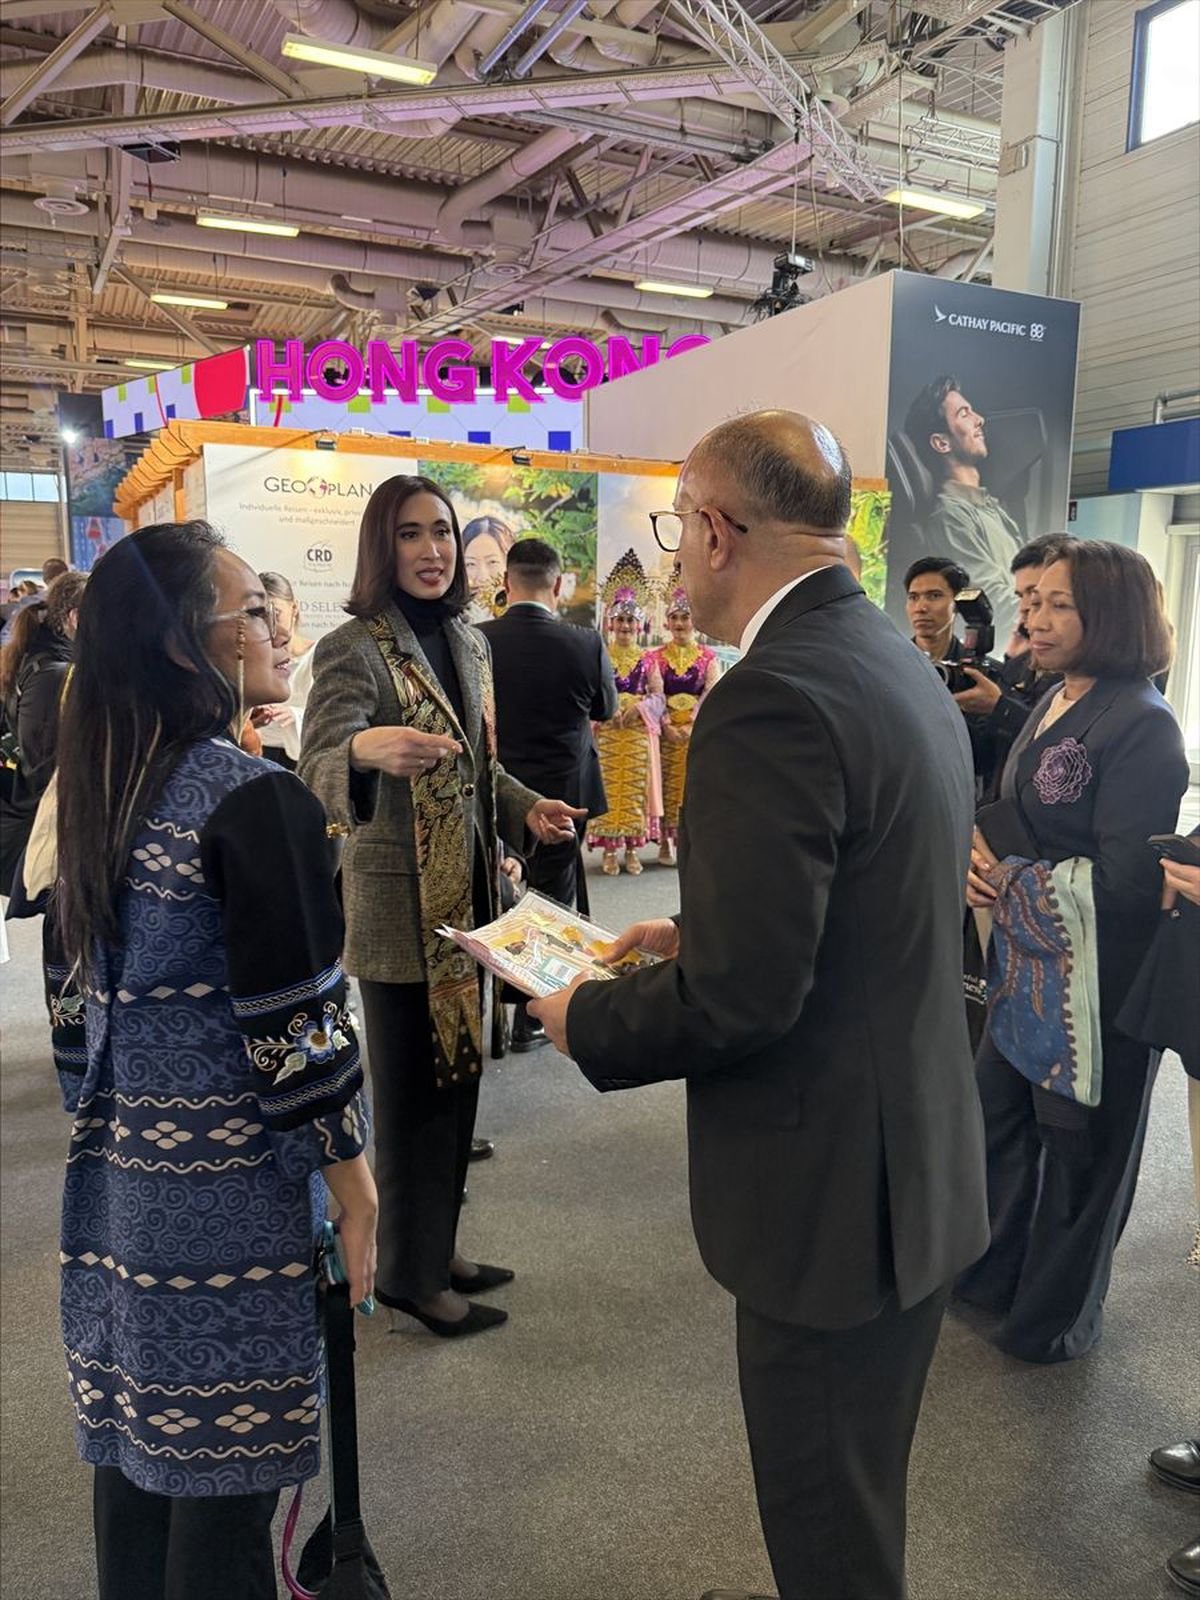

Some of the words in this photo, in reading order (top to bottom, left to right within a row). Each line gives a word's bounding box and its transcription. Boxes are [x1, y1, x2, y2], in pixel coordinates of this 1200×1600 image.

[948, 313, 989, 330] CATHAY
[989, 320, 1026, 336] PACIFIC
[256, 338, 477, 404] HONG
[491, 335, 712, 404] KON
[306, 548, 333, 562] CRD
